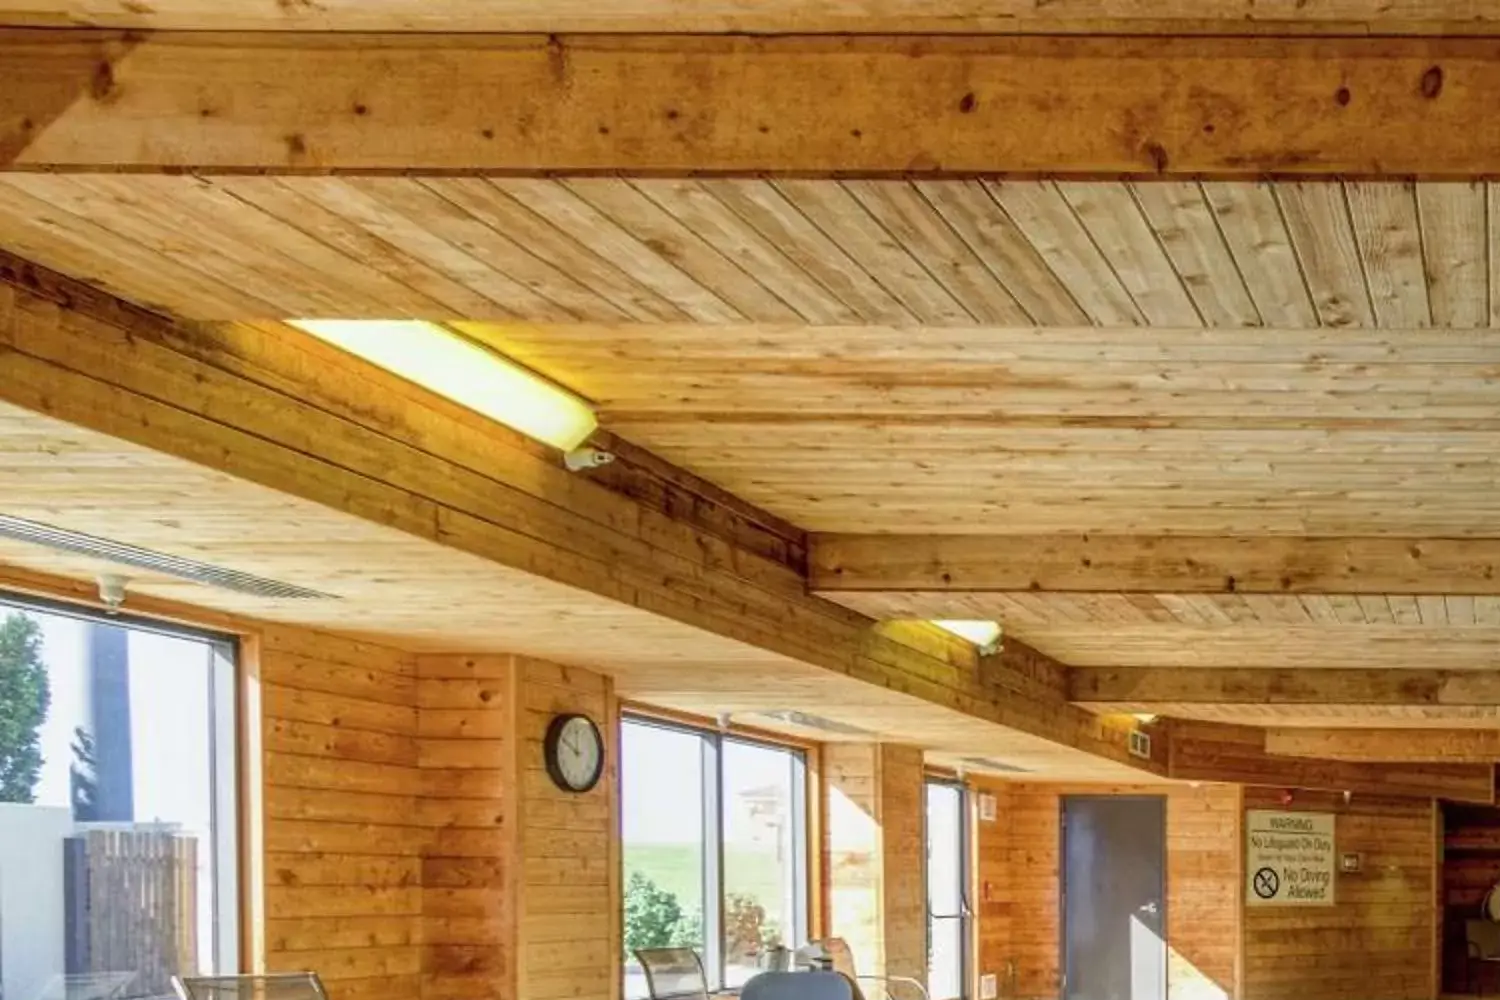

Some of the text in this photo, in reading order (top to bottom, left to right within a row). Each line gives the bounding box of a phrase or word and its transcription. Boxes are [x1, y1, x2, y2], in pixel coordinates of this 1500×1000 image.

[1269, 817, 1313, 831] WARNING
[1283, 867, 1330, 887] No Diving
[1287, 885, 1326, 899] Allowed
